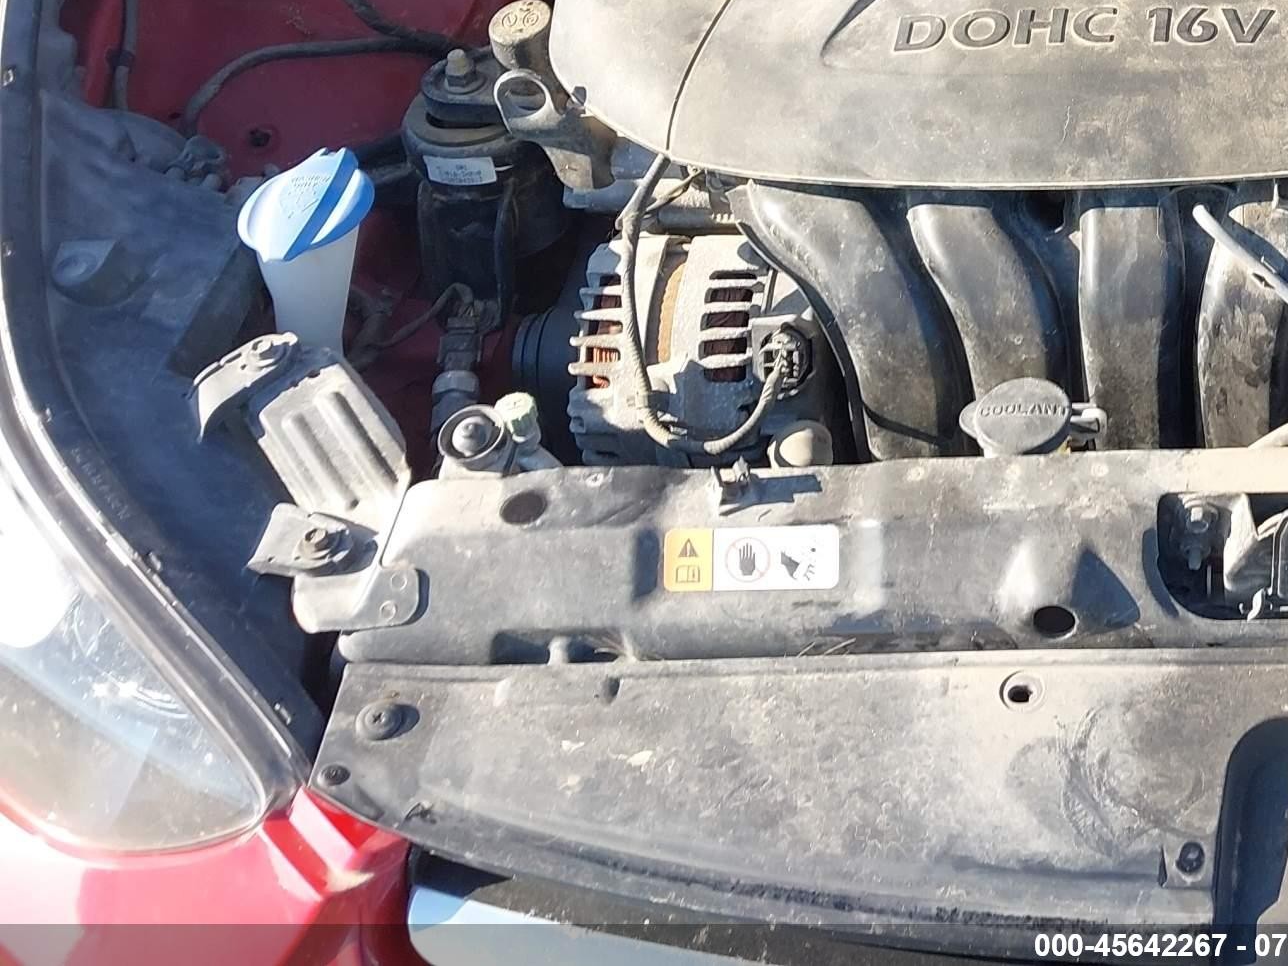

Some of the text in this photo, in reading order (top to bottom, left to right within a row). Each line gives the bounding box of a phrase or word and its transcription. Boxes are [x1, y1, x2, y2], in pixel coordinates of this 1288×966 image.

[894, 7, 1276, 52] DOHC 16V
[980, 402, 1067, 417] COOLANT
